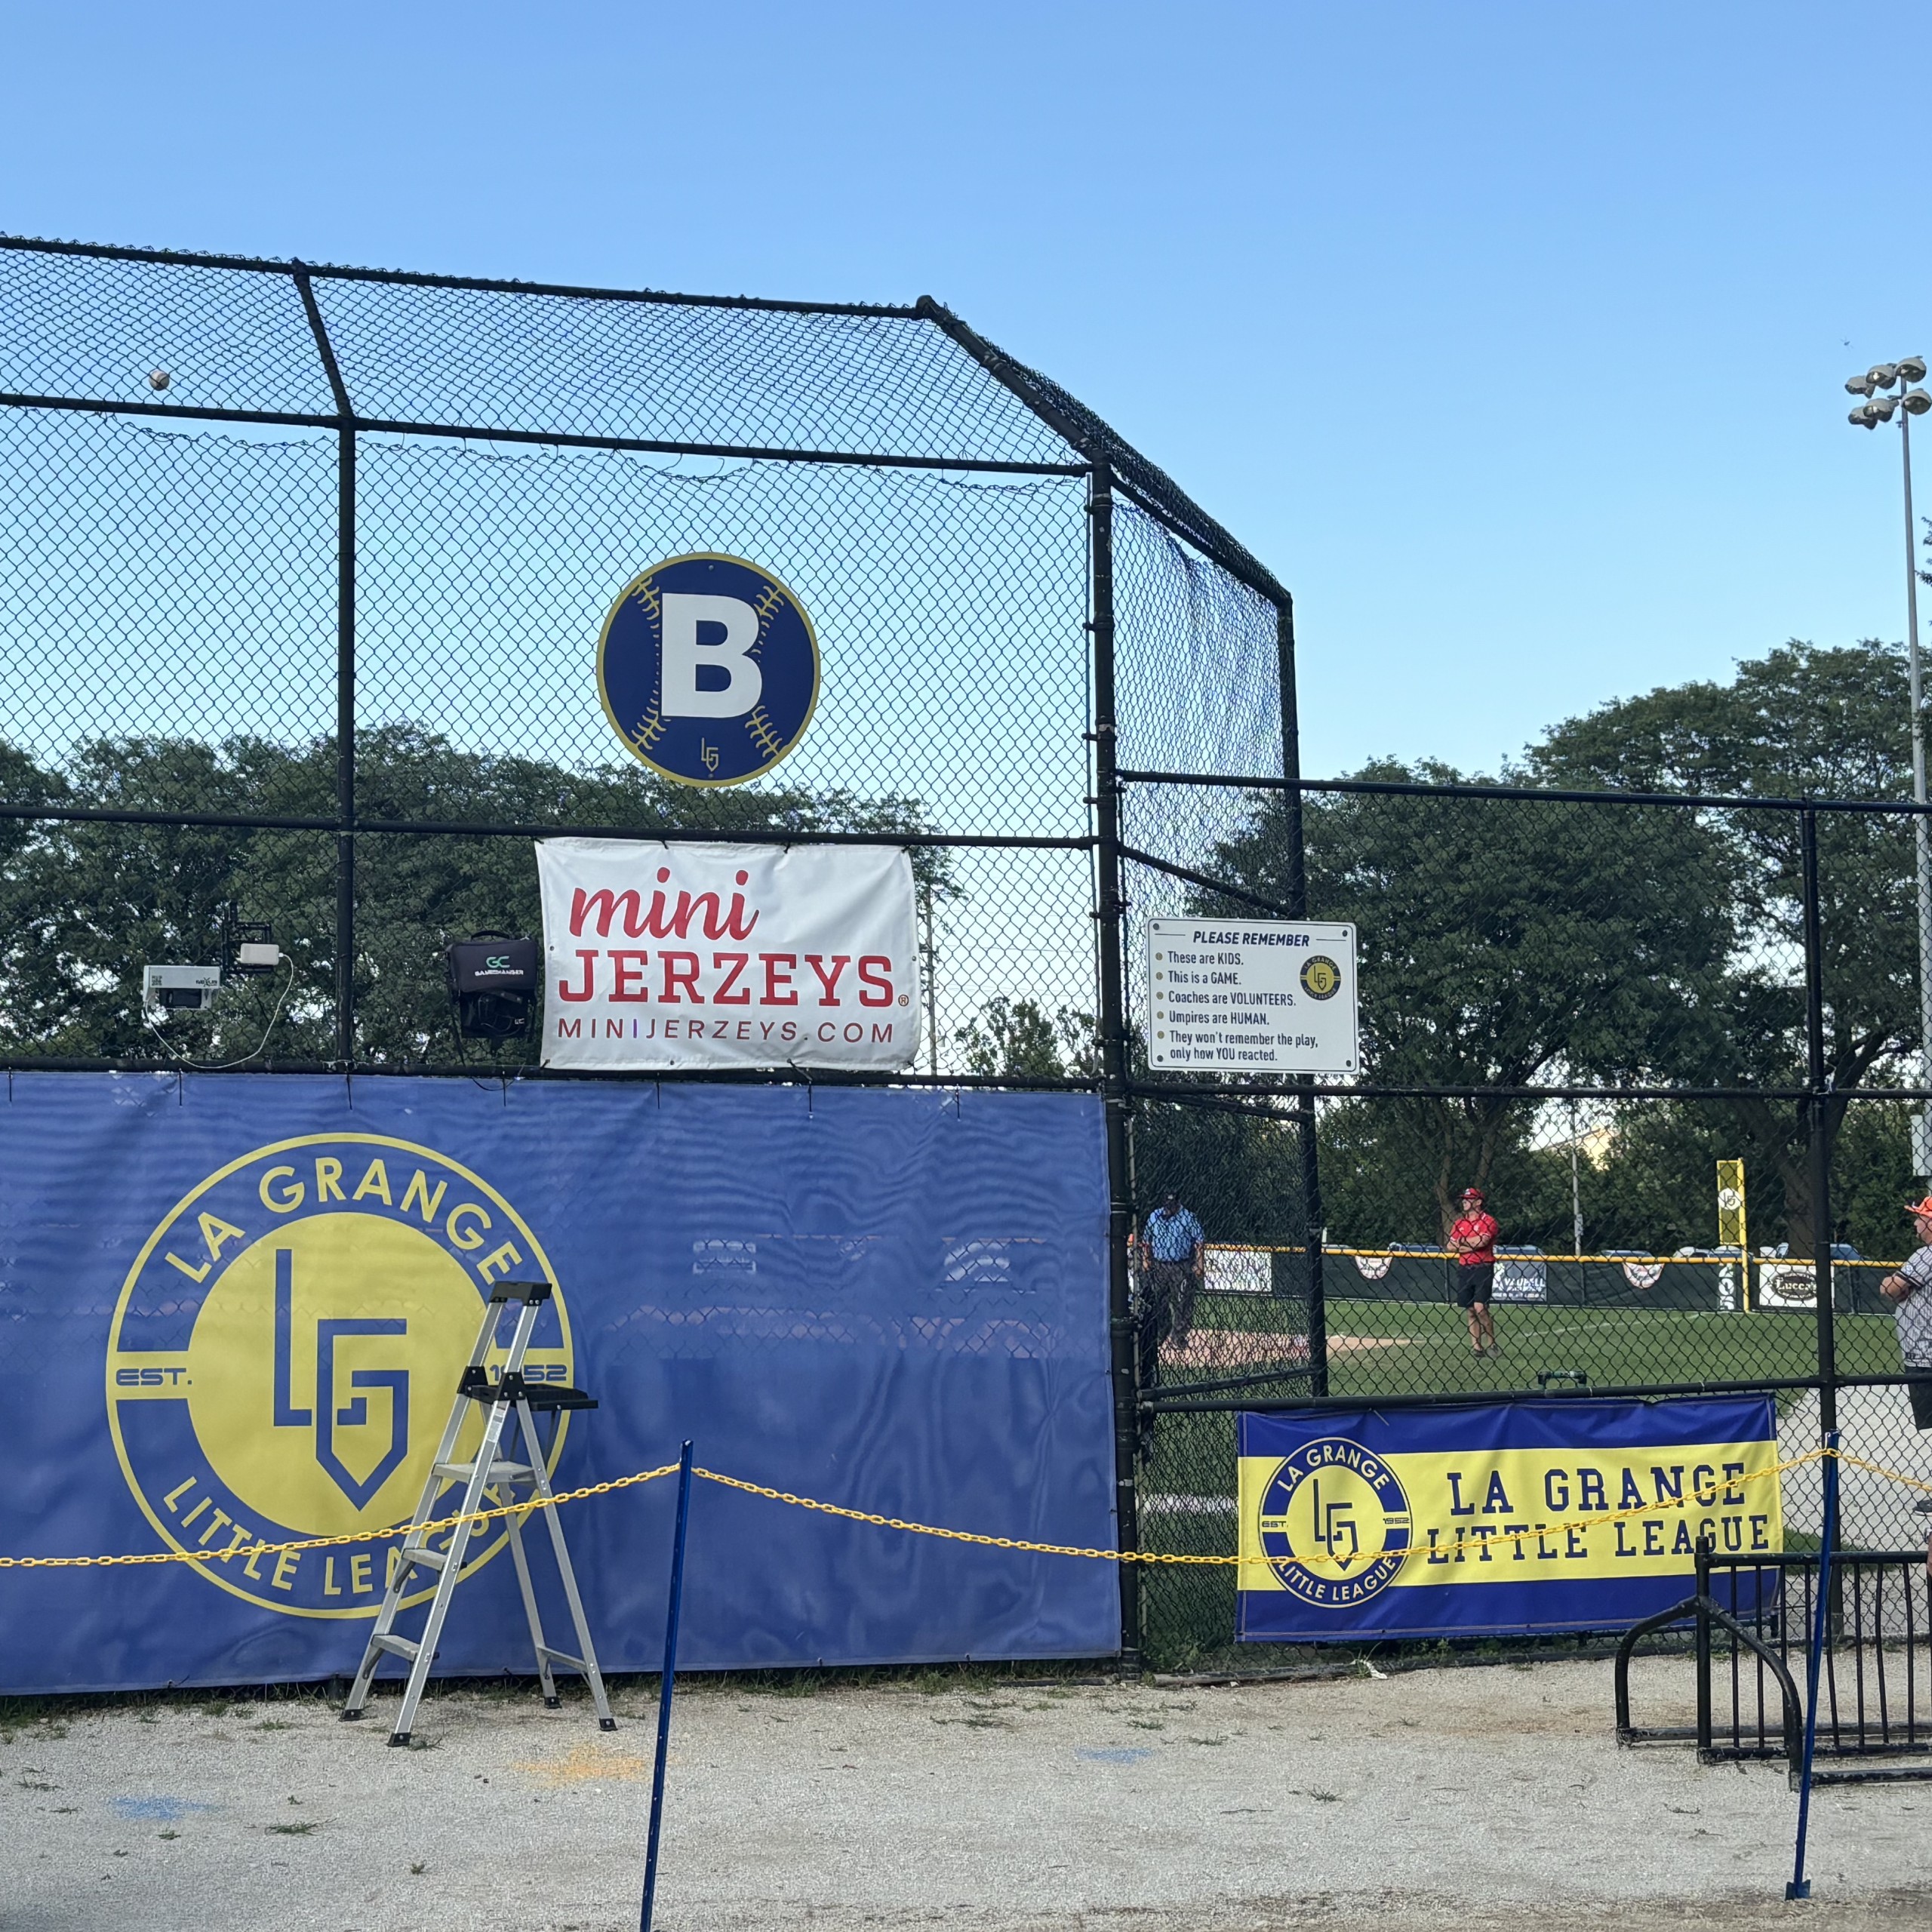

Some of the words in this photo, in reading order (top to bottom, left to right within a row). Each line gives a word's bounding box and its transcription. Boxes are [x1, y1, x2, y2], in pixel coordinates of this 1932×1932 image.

[661, 592, 762, 718] B
[569, 866, 759, 941] mini
[1192, 931, 1239, 945] PLEASE
[1242, 932, 1310, 946] REMEMBER
[1168, 951, 1196, 964] These
[1199, 955, 1214, 965] are
[1217, 952, 1244, 965] KIDS.
[1168, 971, 1189, 983] This
[1191, 972, 1200, 984] is
[1201, 975, 1208, 984] a
[1211, 972, 1241, 985] GAME.
[1168, 990, 1211, 1004] Coaches
[1212, 995, 1228, 1004] are
[1230, 992, 1297, 1006] VOLUNTEERS.
[558, 1018, 893, 1044] MINIJERZEYS.COM
[1169, 1010, 1210, 1026] Umpires
[1212, 1014, 1228, 1024] are
[1230, 1012, 1269, 1026] HUMAN.
[1170, 1030, 1193, 1047] They
[1195, 1031, 1223, 1044] won't
[1225, 1032, 1274, 1045] remember
[1277, 1033, 1293, 1046] the
[1295, 1034, 1318, 1048] play,
[1170, 1047, 1191, 1062] only
[1194, 1047, 1214, 1060] how
[1216, 1048, 1235, 1060] YOU
[1238, 1048, 1278, 1061] reacted.
[165, 1211, 245, 1283] LA
[259, 1156, 522, 1285] GRANGE
[115, 1367, 193, 1386] EST.
[273, 1249, 409, 1511] LG
[489, 1364, 568, 1382] 152
[1277, 1466, 1303, 1492] LA
[1306, 1444, 1390, 1491] GRANGE
[1447, 1470, 1514, 1515] LA
[1544, 1462, 1745, 1512] GRANGE
[163, 1476, 301, 1591] LITTLE
[1427, 1523, 1587, 1564] LITTLE
[1614, 1514, 1769, 1557] LEAGUE
[1278, 1559, 1326, 1599] LITTLE
[1332, 1555, 1396, 1601] LEAGUE
